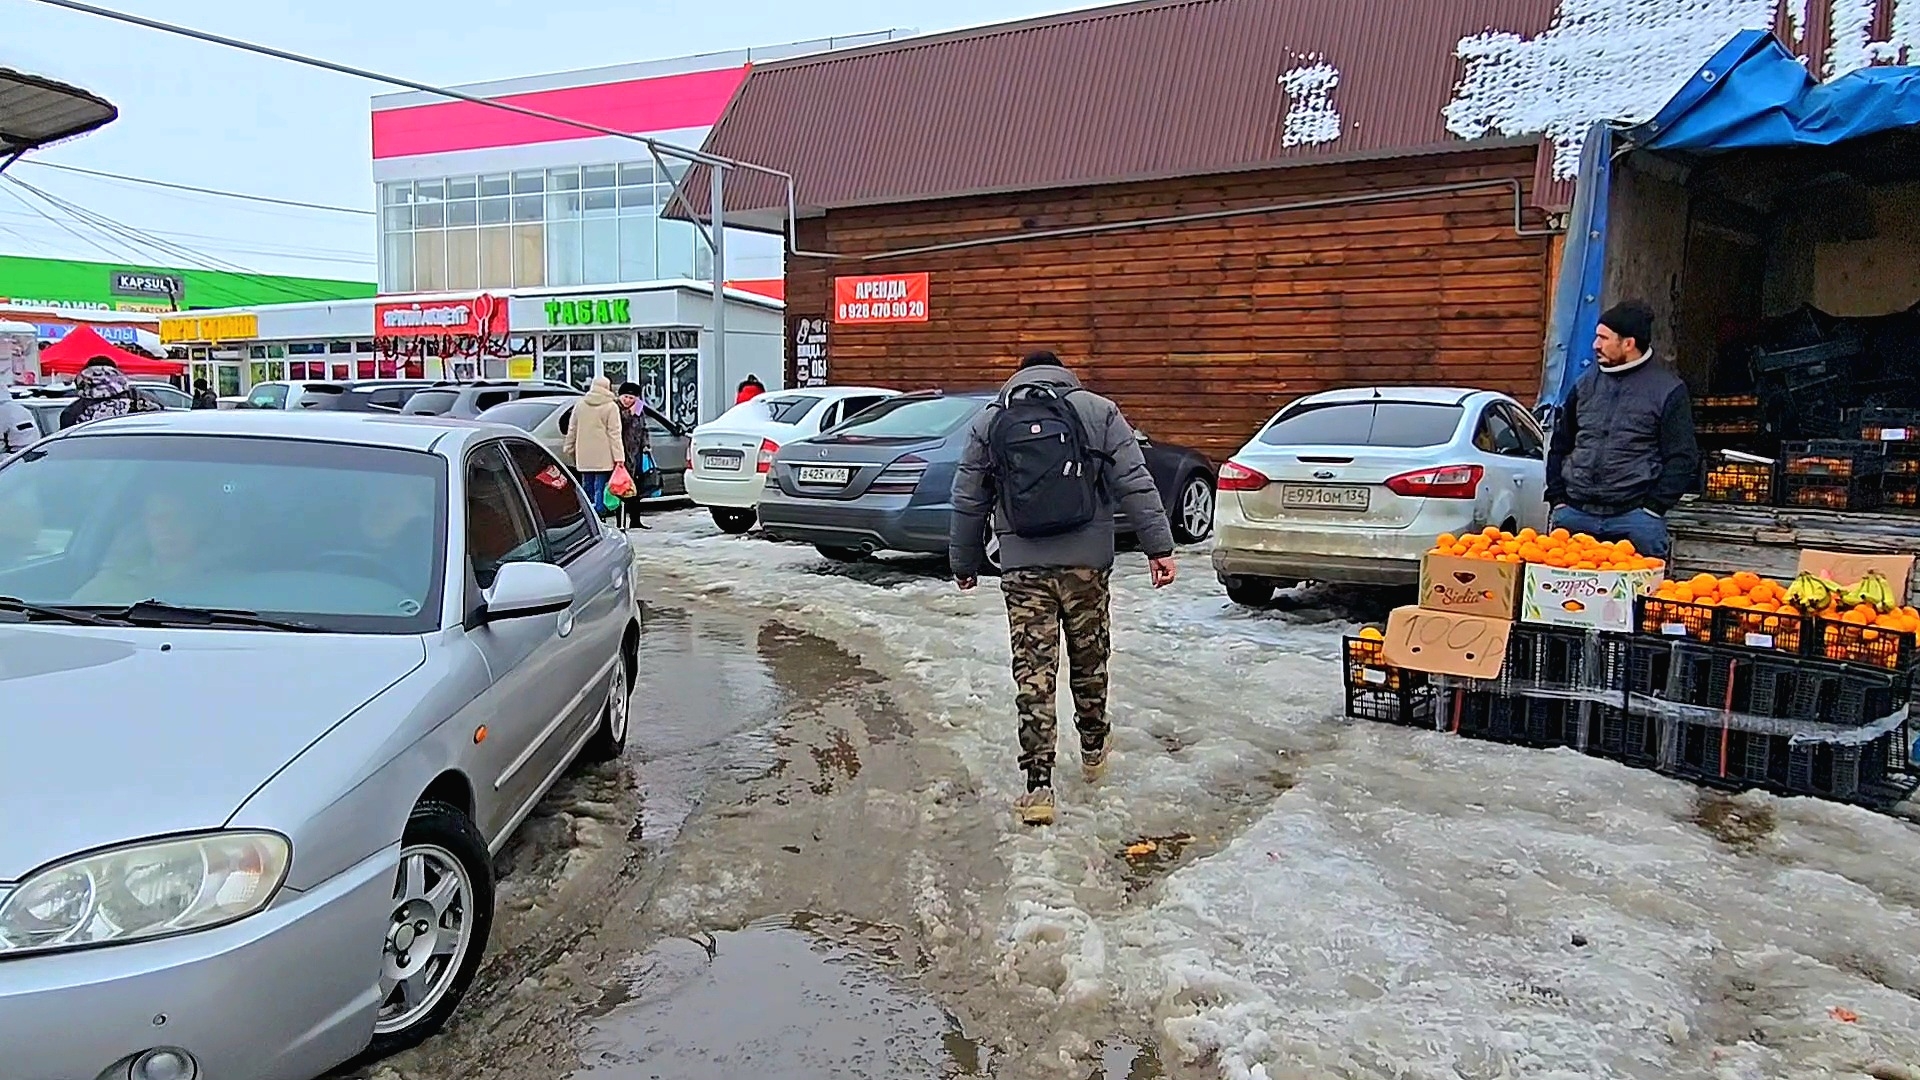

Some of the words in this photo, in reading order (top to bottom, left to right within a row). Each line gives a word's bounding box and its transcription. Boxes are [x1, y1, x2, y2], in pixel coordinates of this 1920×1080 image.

[855, 280, 907, 301] АРЕНДА
[383, 303, 421, 327] ЯРКИЙ
[421, 306, 469, 327] АКЦЕНТ
[544, 298, 631, 325] ТАБАК
[839, 303, 847, 320] 8
[848, 303, 870, 319] 928
[871, 301, 891, 318] 470
[892, 301, 907, 317] 90
[908, 300, 924, 317] 20
[1288, 488, 1341, 503] Е991ОМ
[1343, 489, 1365, 501] 134
